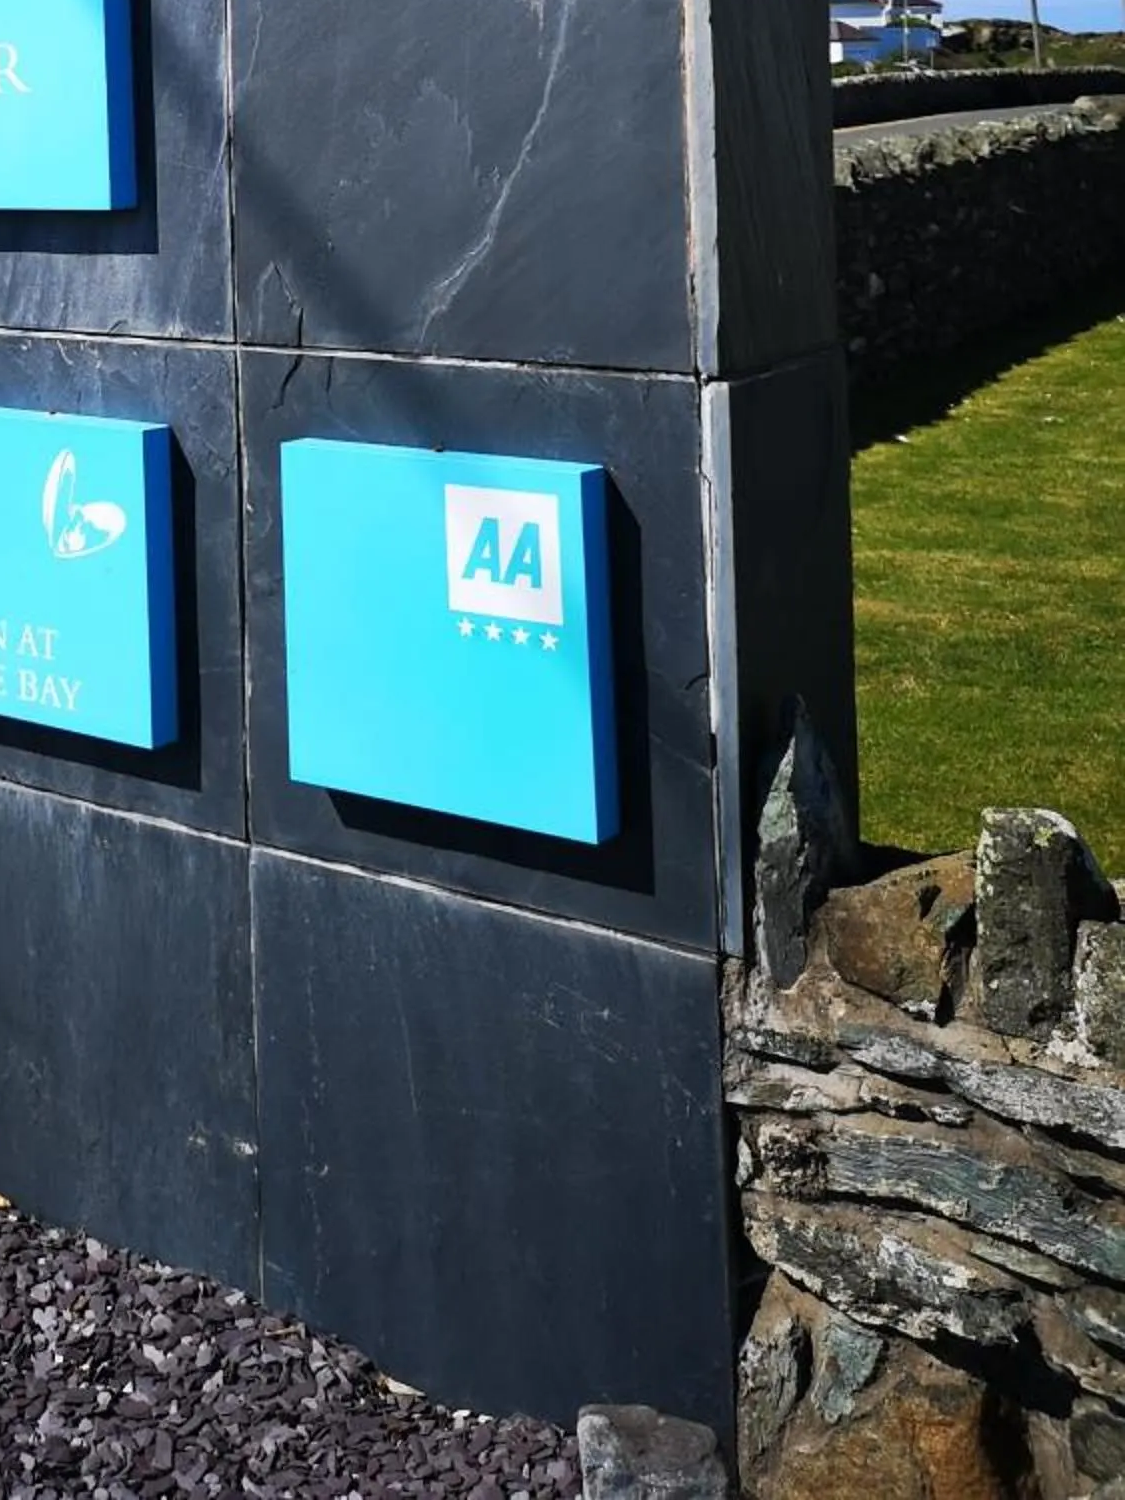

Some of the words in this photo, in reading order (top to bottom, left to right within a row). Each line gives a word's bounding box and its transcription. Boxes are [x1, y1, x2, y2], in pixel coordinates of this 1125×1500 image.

[461, 517, 543, 589] AA
[16, 622, 60, 661] AT
[18, 669, 82, 712] BAY
